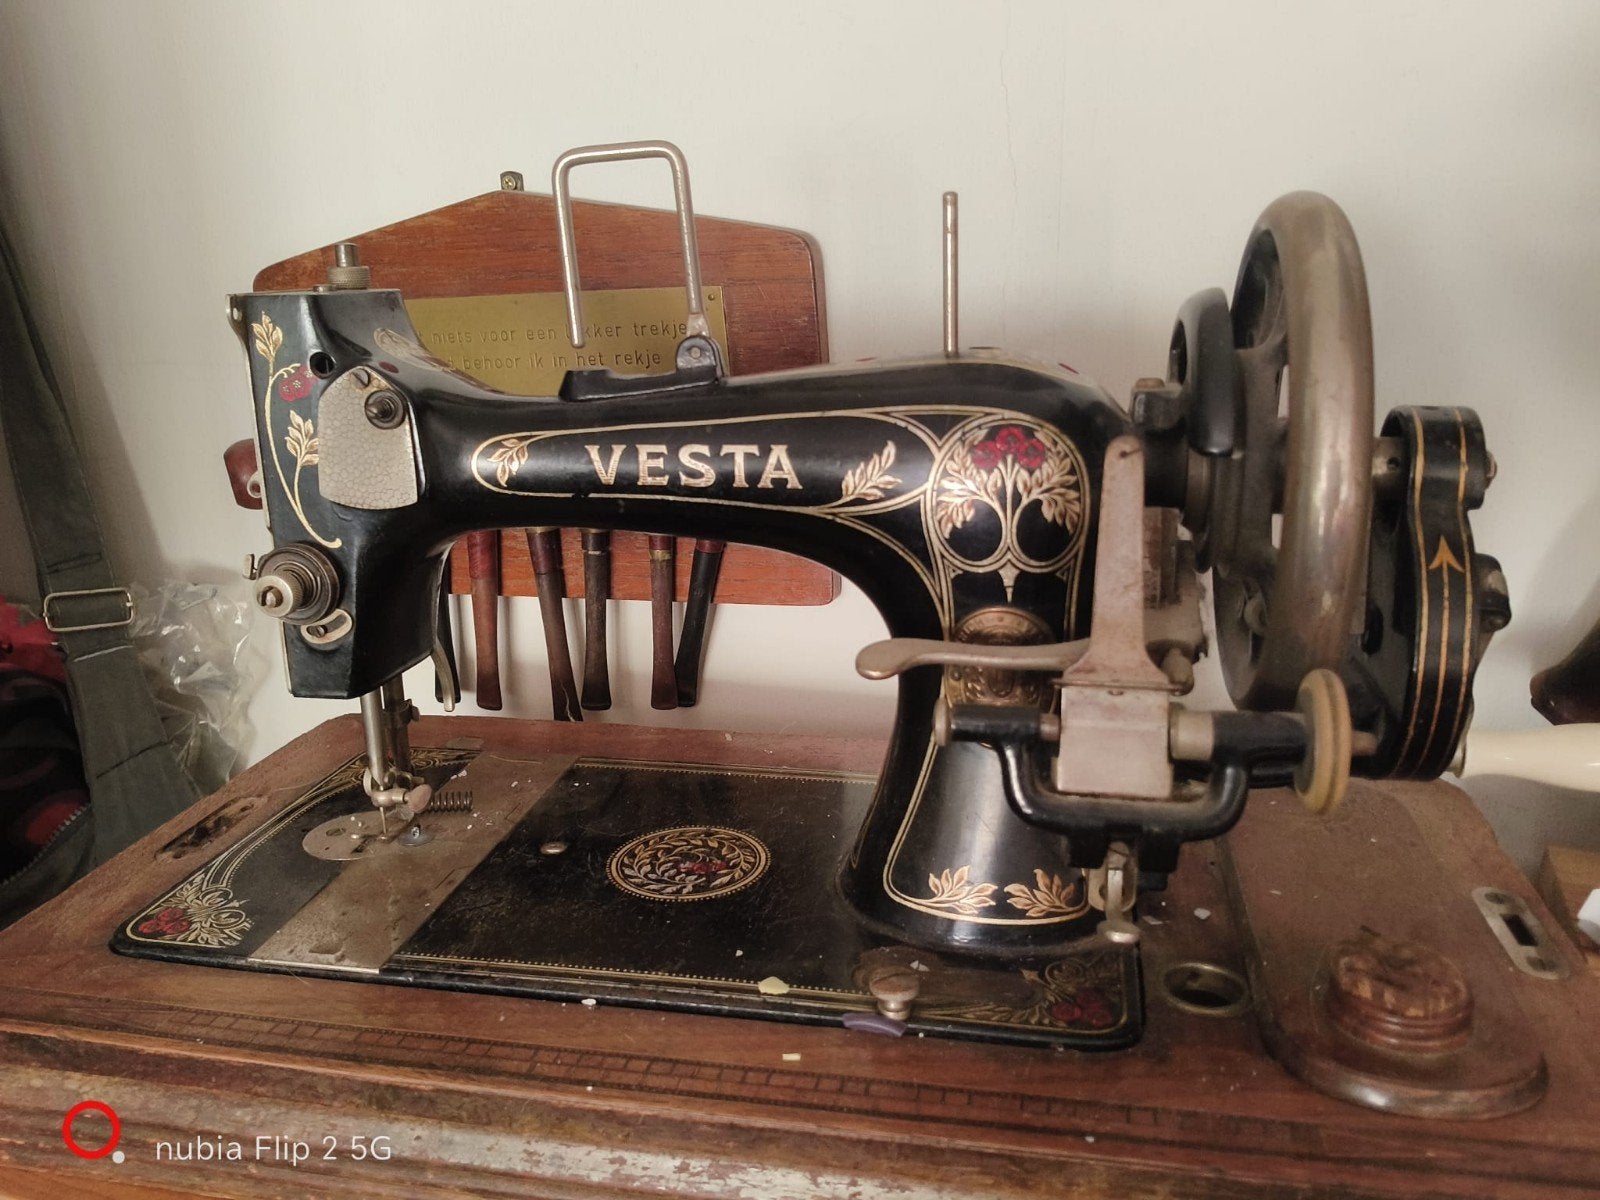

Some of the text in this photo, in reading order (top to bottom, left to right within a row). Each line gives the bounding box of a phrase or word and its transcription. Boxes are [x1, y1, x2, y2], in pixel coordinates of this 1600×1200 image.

[479, 328, 516, 343] voor
[526, 326, 557, 341] een
[633, 319, 687, 340] trekje
[462, 353, 521, 369] behoor
[529, 351, 544, 368] ik
[552, 352, 567, 368] in
[576, 351, 604, 366] het
[615, 349, 661, 369] rekje
[584, 444, 803, 489] VESTA
